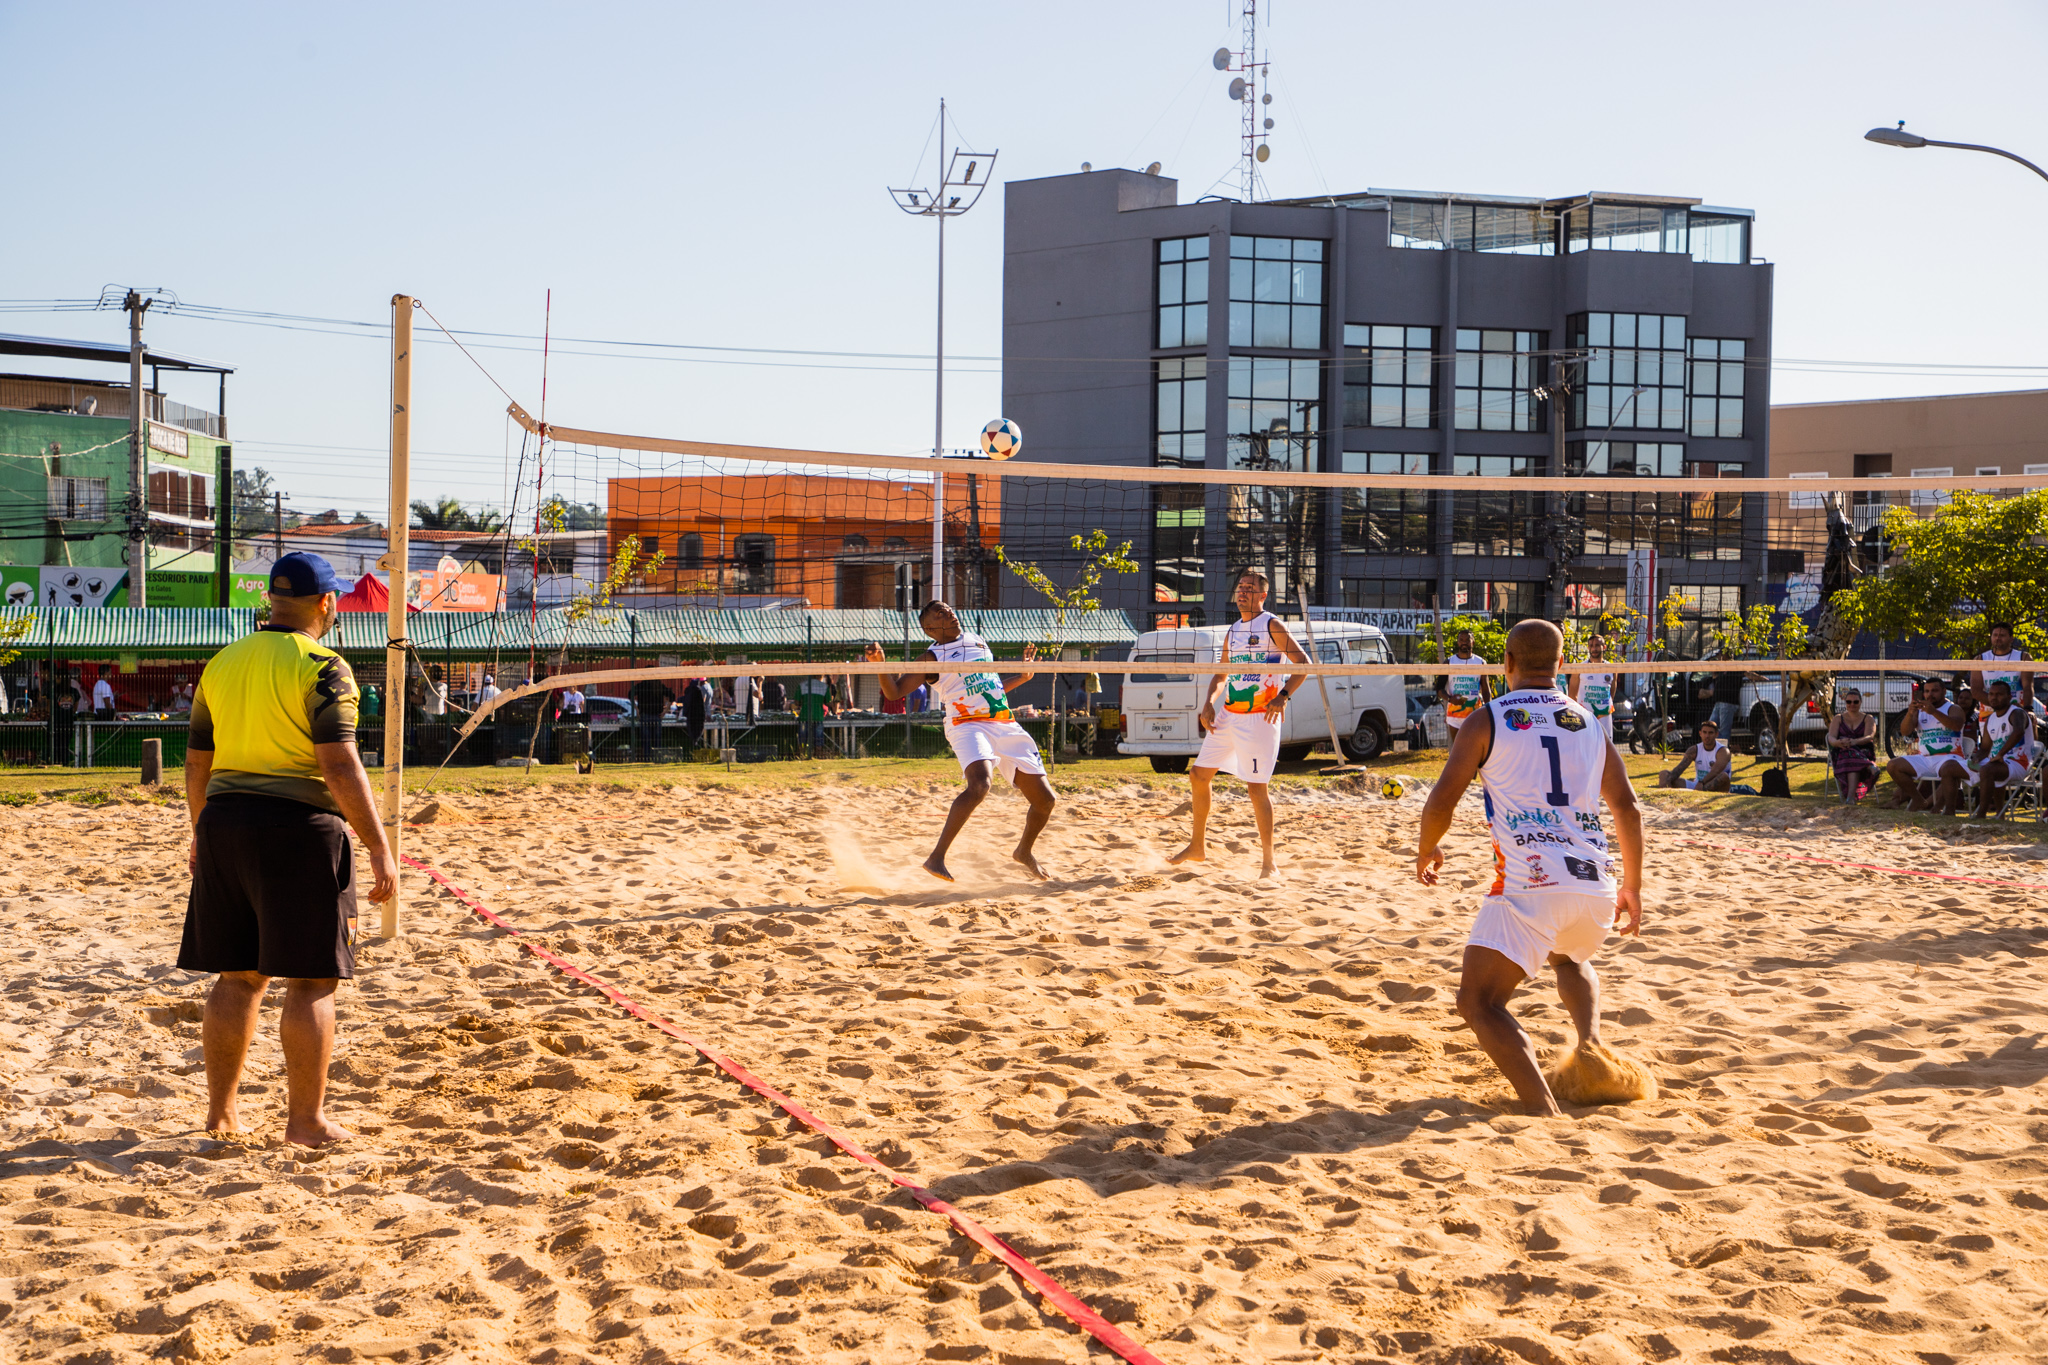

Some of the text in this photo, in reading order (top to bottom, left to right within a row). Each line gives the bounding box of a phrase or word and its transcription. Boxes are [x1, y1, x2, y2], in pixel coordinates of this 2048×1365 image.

[145, 571, 209, 584] CESSÓRIOS PARA
[236, 577, 265, 592] Agro
[458, 581, 476, 594] Centro
[458, 595, 487, 606] Automotivo
[1499, 695, 1540, 707] Mercado
[1252, 758, 1259, 774] 1
[1540, 735, 1569, 807] 1
